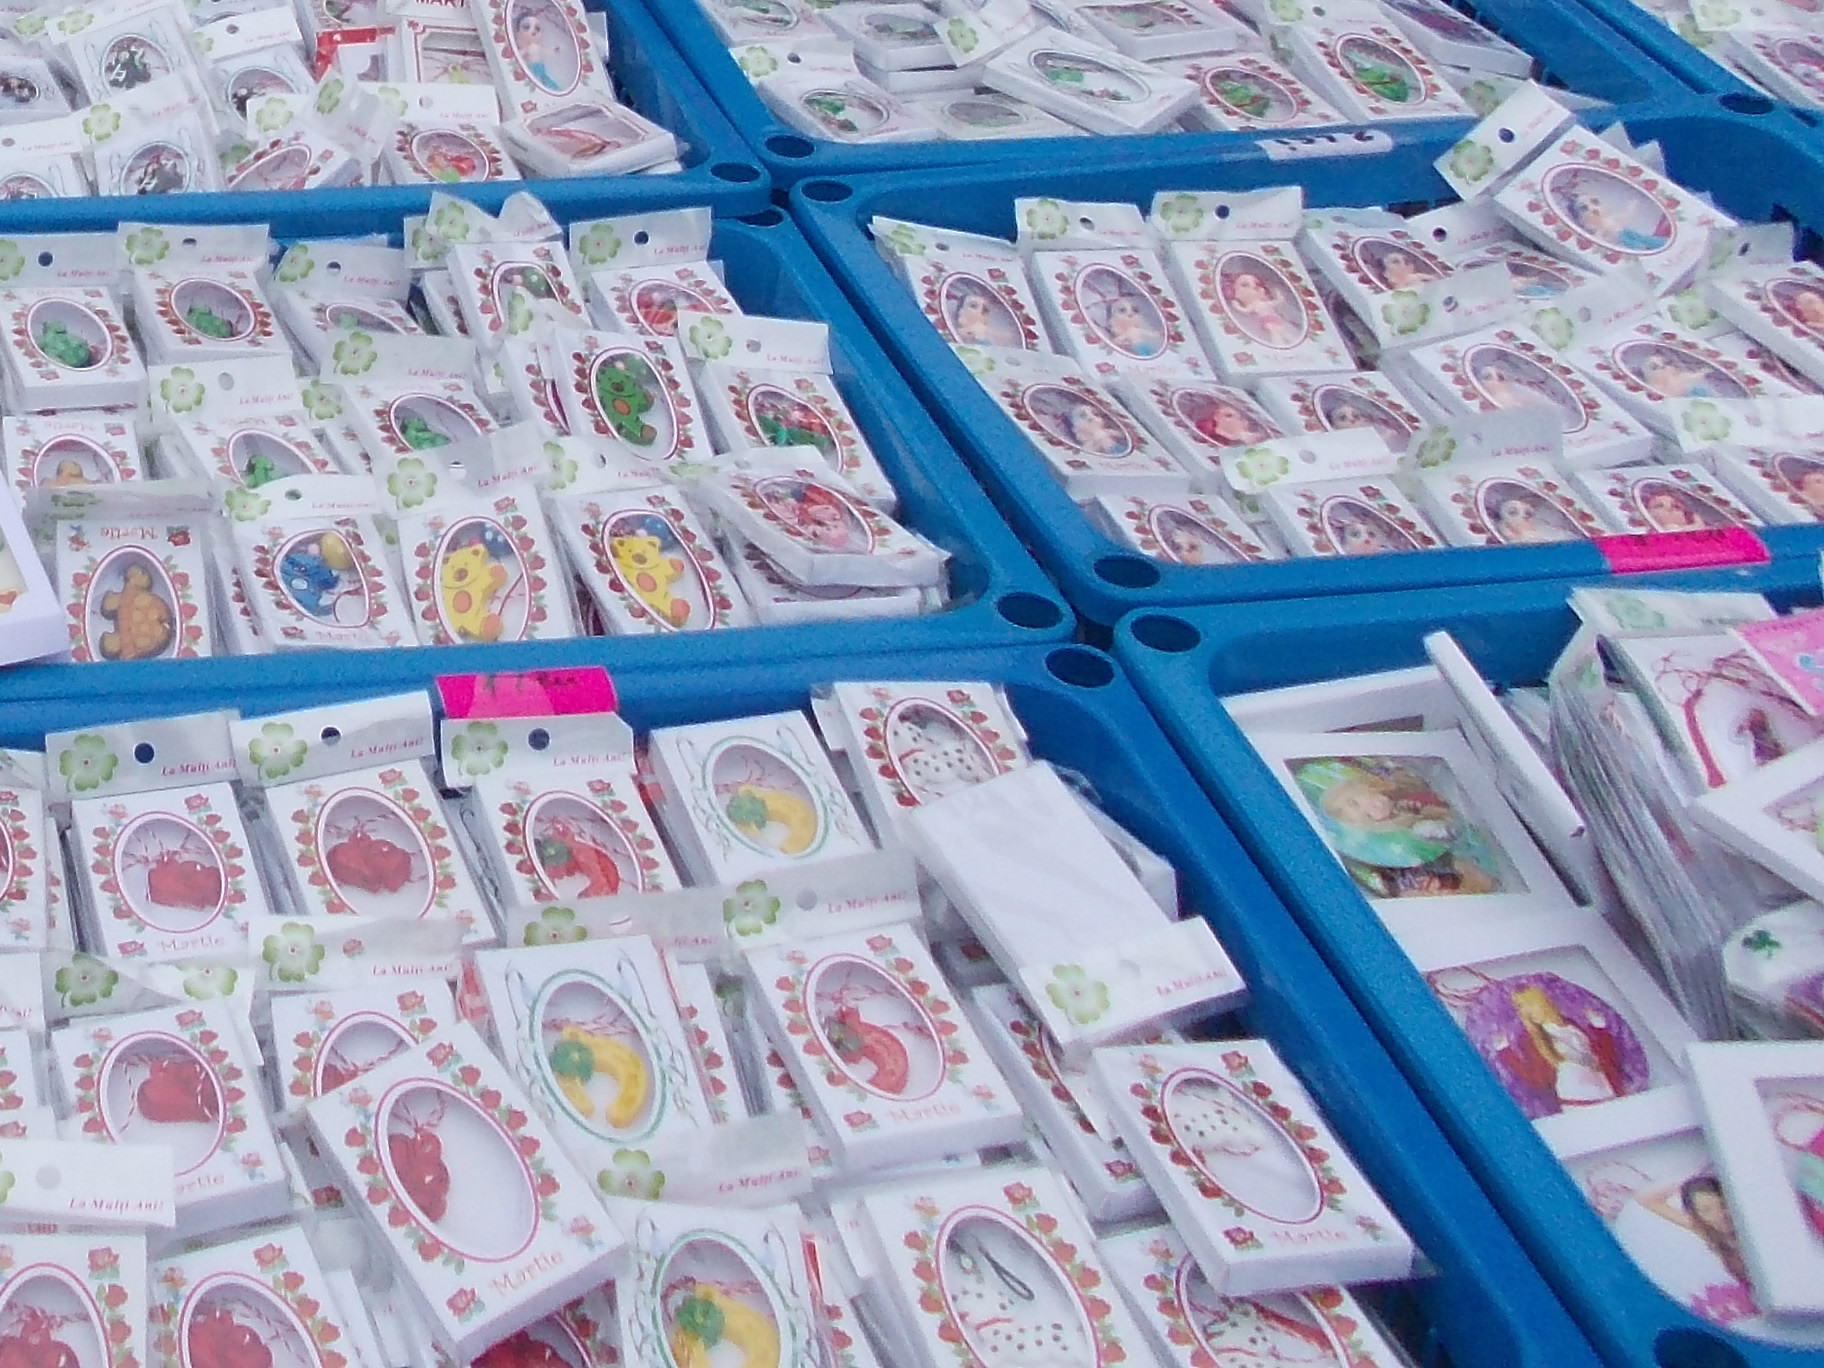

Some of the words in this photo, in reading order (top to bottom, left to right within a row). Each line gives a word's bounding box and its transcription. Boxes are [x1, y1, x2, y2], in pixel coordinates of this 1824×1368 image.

[100, 526, 159, 541] Martie
[161, 935, 225, 952] Martie
[68, 1197, 86, 1210] La
[489, 1250, 564, 1295] Martie
